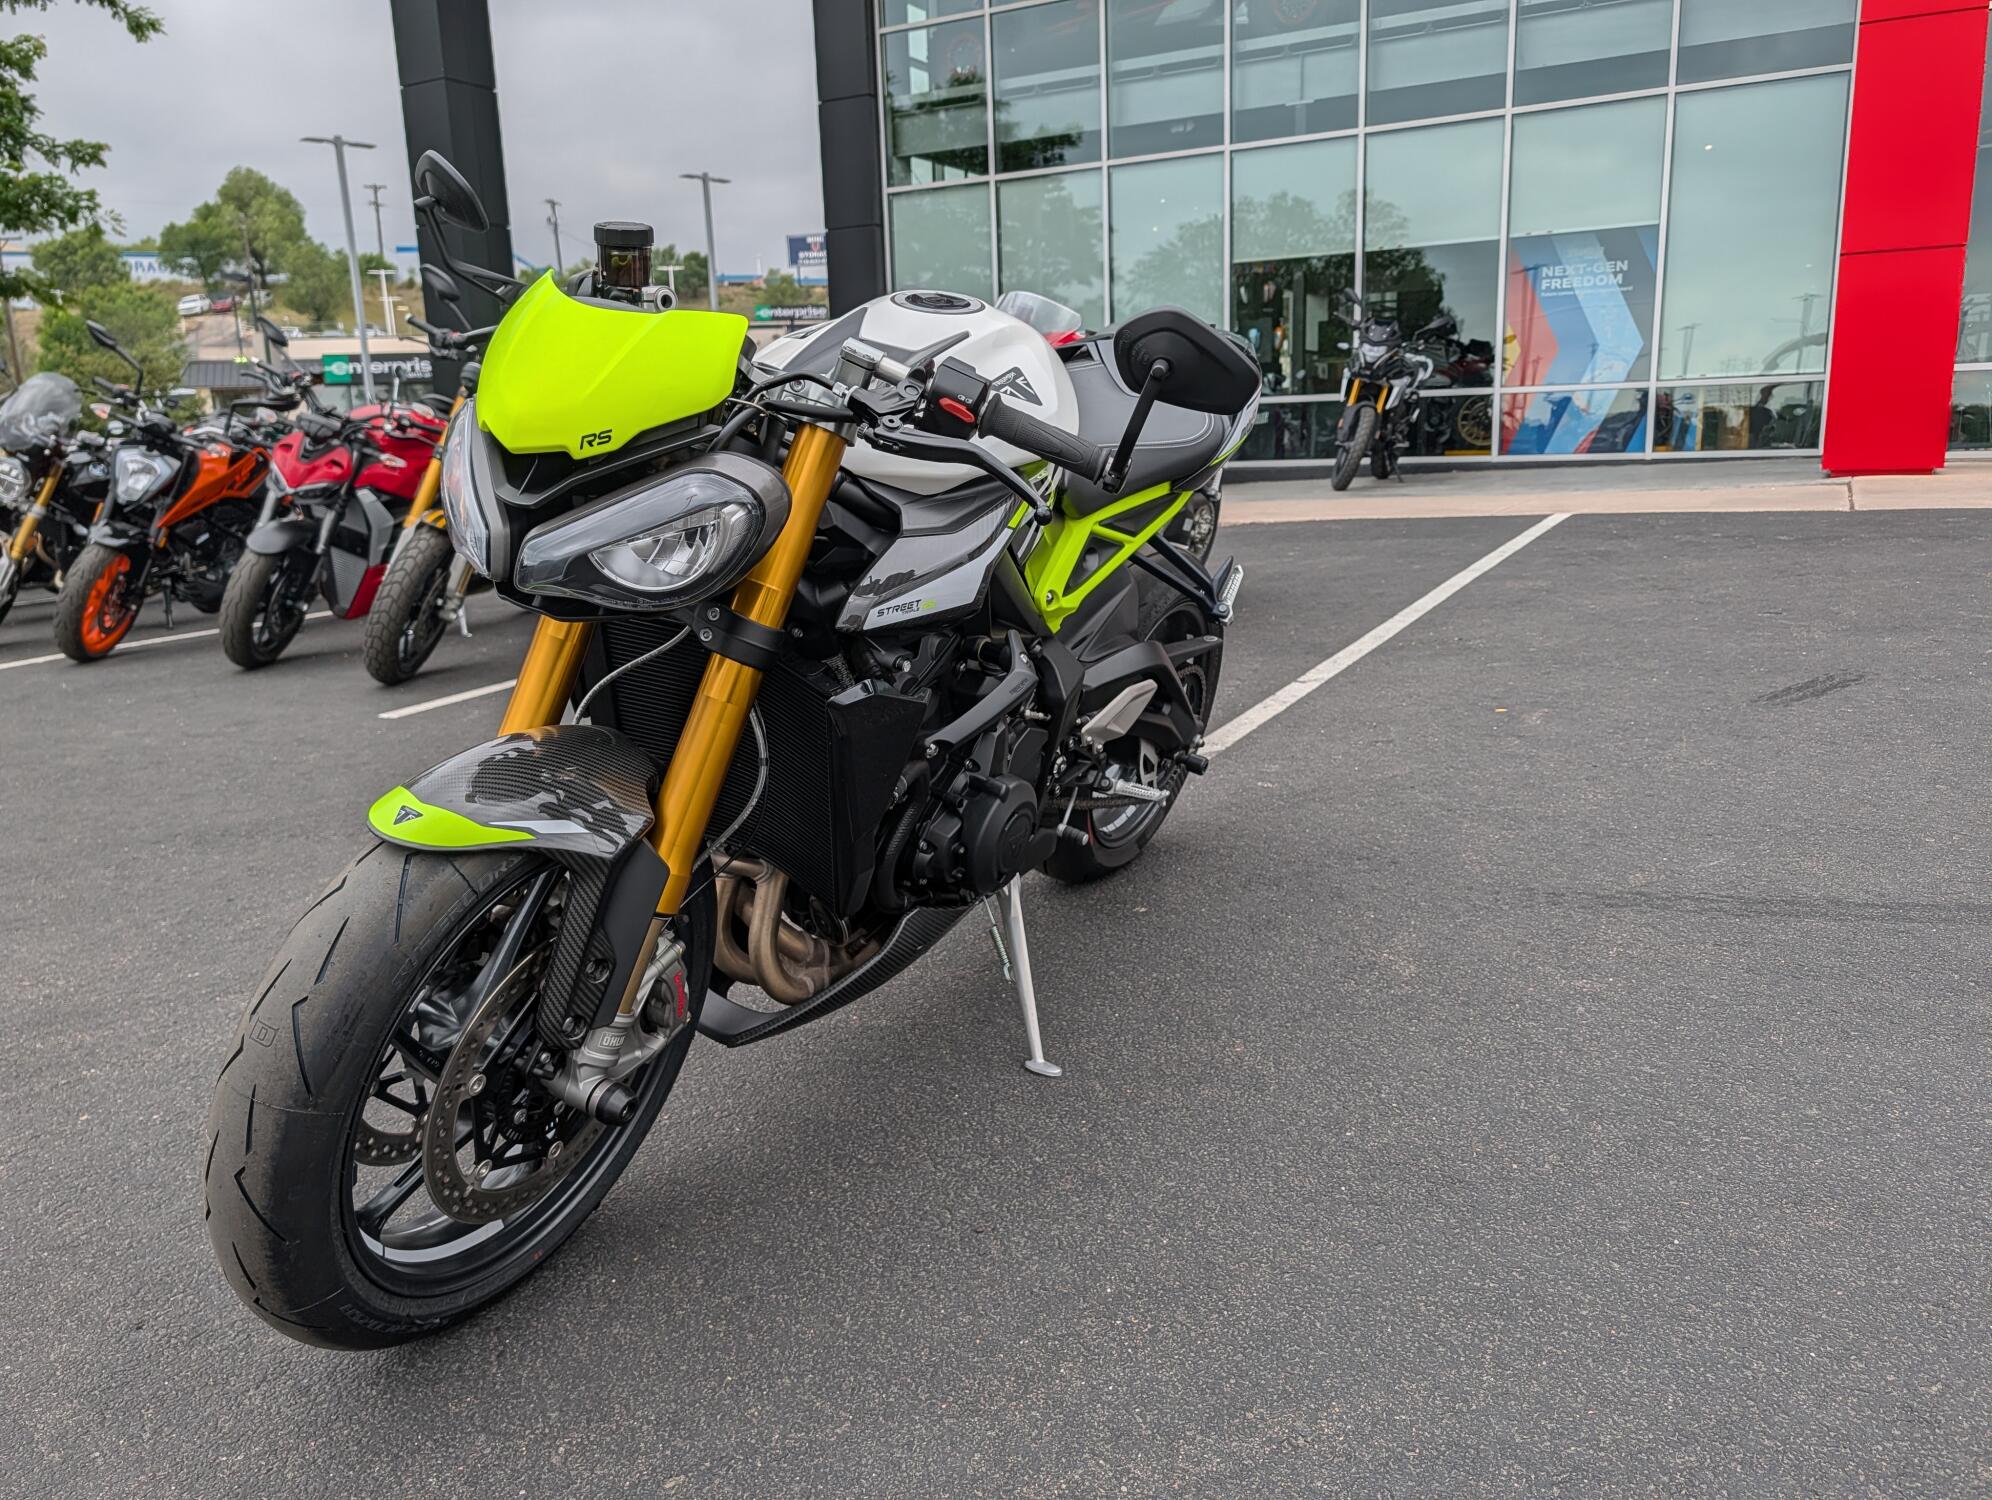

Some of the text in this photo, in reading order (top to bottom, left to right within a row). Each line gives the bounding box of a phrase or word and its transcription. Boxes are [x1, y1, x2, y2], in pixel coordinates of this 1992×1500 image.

[1541, 260, 1629, 278] NEXT-GEN
[1541, 273, 1623, 290] FREEDOM
[580, 429, 612, 450] RS
[877, 599, 922, 618] STREET
